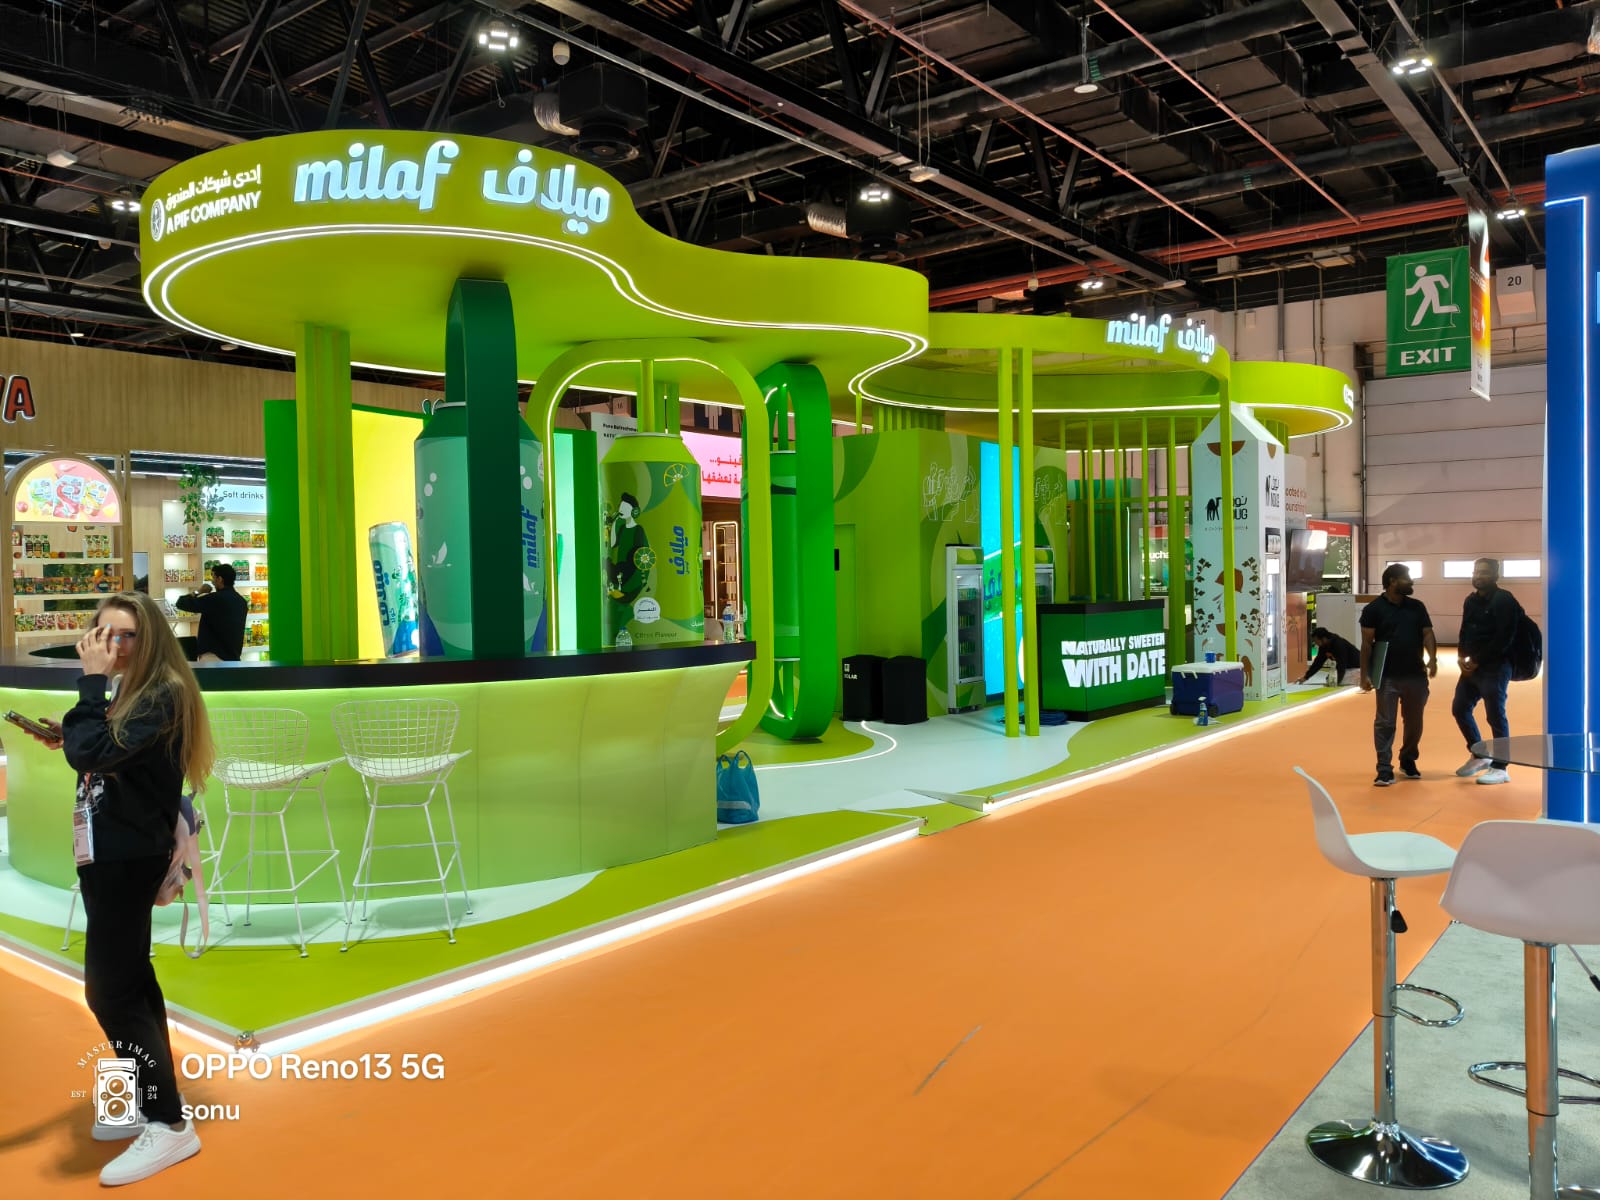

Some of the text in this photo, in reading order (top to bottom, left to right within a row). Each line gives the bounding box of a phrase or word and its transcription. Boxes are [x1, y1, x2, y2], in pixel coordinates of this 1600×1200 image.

[293, 140, 459, 210] milaf
[482, 149, 610, 234] ميلاف
[166, 191, 262, 235] A PIF COMPANY
[1507, 276, 1522, 286] 20
[1107, 313, 1172, 353] milaf
[1178, 318, 1215, 363] ميلاف
[1401, 347, 1456, 365] EXIT
[0, 375, 36, 423] A
[240, 491, 265, 500] drinks
[520, 504, 538, 568] milaf
[1061, 637, 1126, 655] NATURALLY
[1061, 648, 1166, 688] WITH DATE
